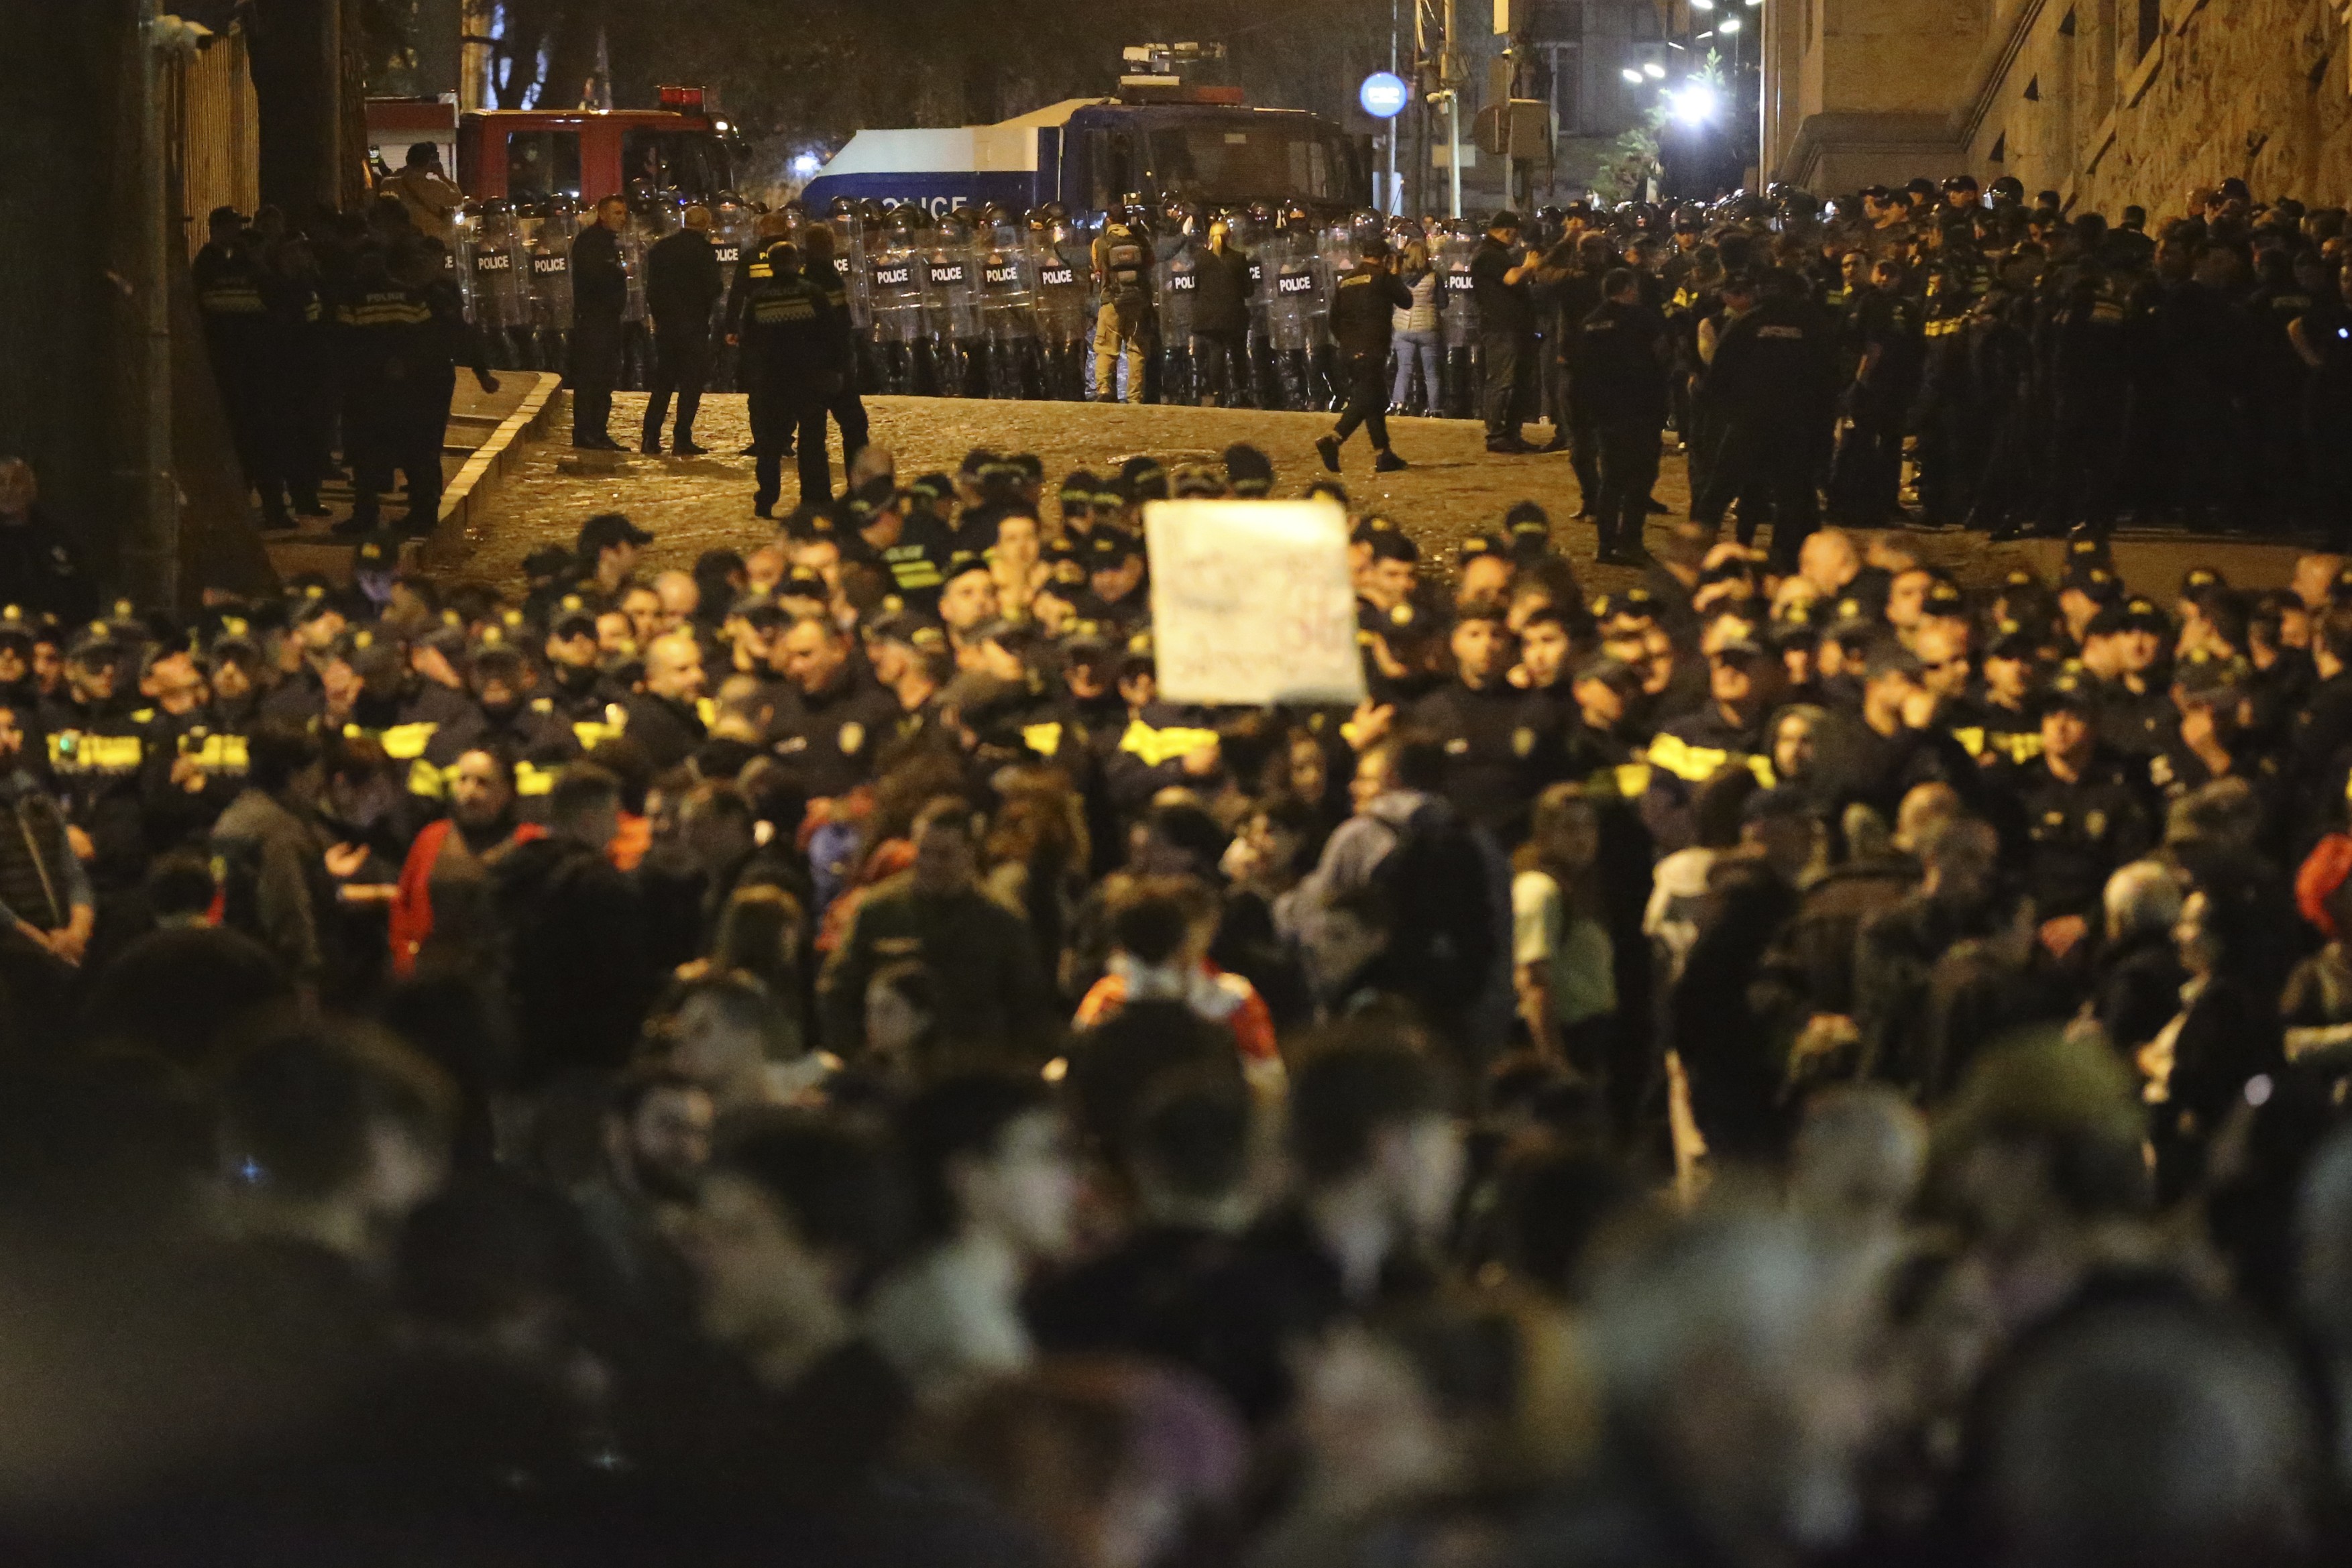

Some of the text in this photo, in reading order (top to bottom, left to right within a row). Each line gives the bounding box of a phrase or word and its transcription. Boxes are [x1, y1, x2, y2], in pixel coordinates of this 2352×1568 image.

[478, 256, 509, 270] POLICE
[535, 258, 565, 272] POLICE
[877, 269, 908, 284] POLICE
[931, 267, 962, 281] POLICE
[987, 267, 1017, 282] POLICE
[1042, 270, 1073, 284] POLICE
[1174, 276, 1195, 289] POLI
[1280, 276, 1311, 292] POLICE
[1449, 276, 1473, 289] POLIC
